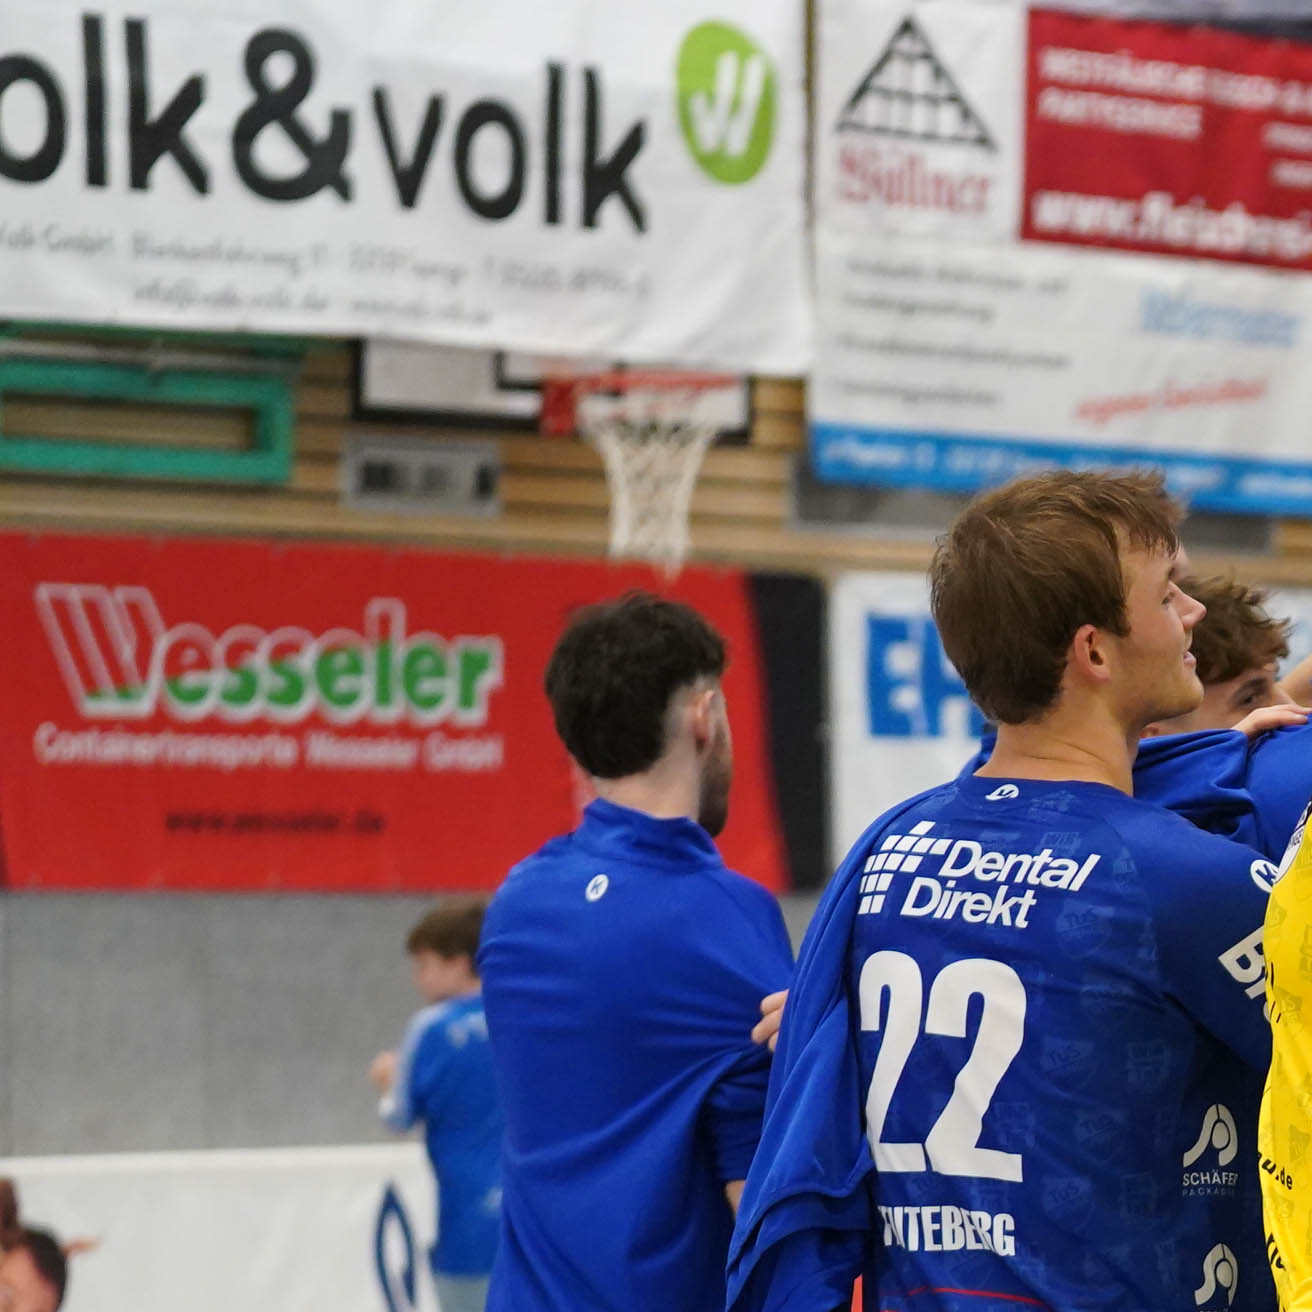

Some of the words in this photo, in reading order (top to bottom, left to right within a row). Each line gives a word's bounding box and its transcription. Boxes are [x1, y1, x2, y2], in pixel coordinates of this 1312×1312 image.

[34, 580, 503, 727] Wesseler
[34, 722, 297, 772] Containertransporte
[307, 730, 418, 769] Wesseler
[424, 730, 502, 772] GmbH
[937, 837, 1100, 892] Dental
[899, 876, 1037, 929] Direkt
[859, 950, 1028, 1182] 22
